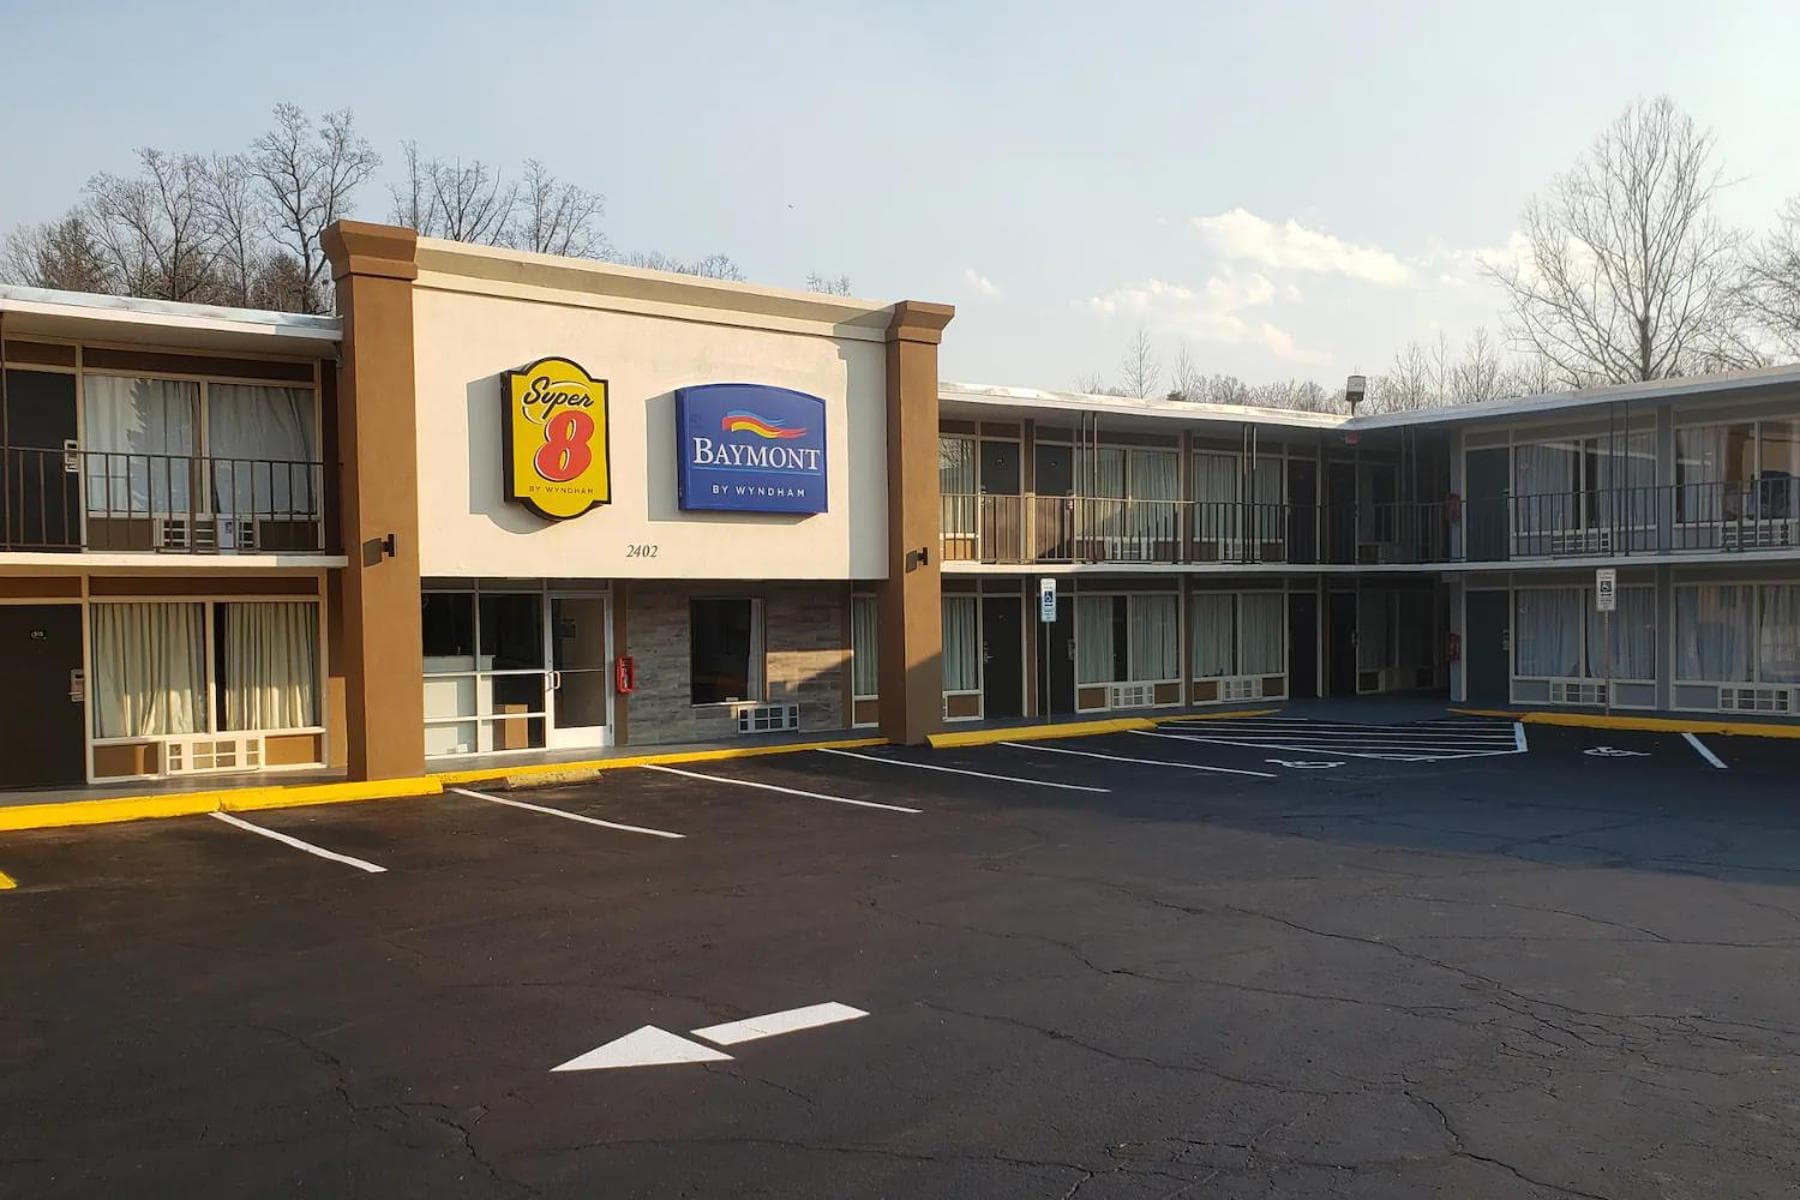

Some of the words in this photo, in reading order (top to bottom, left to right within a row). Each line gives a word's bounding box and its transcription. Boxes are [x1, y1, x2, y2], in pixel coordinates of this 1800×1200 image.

[523, 376, 594, 420] Super
[534, 410, 595, 483] 8
[693, 437, 821, 470] BAYMONT
[545, 486, 594, 494] WYNDHAM
[712, 485, 729, 494] BY
[736, 486, 805, 497] WYNDHAM
[626, 544, 658, 558] 2402
